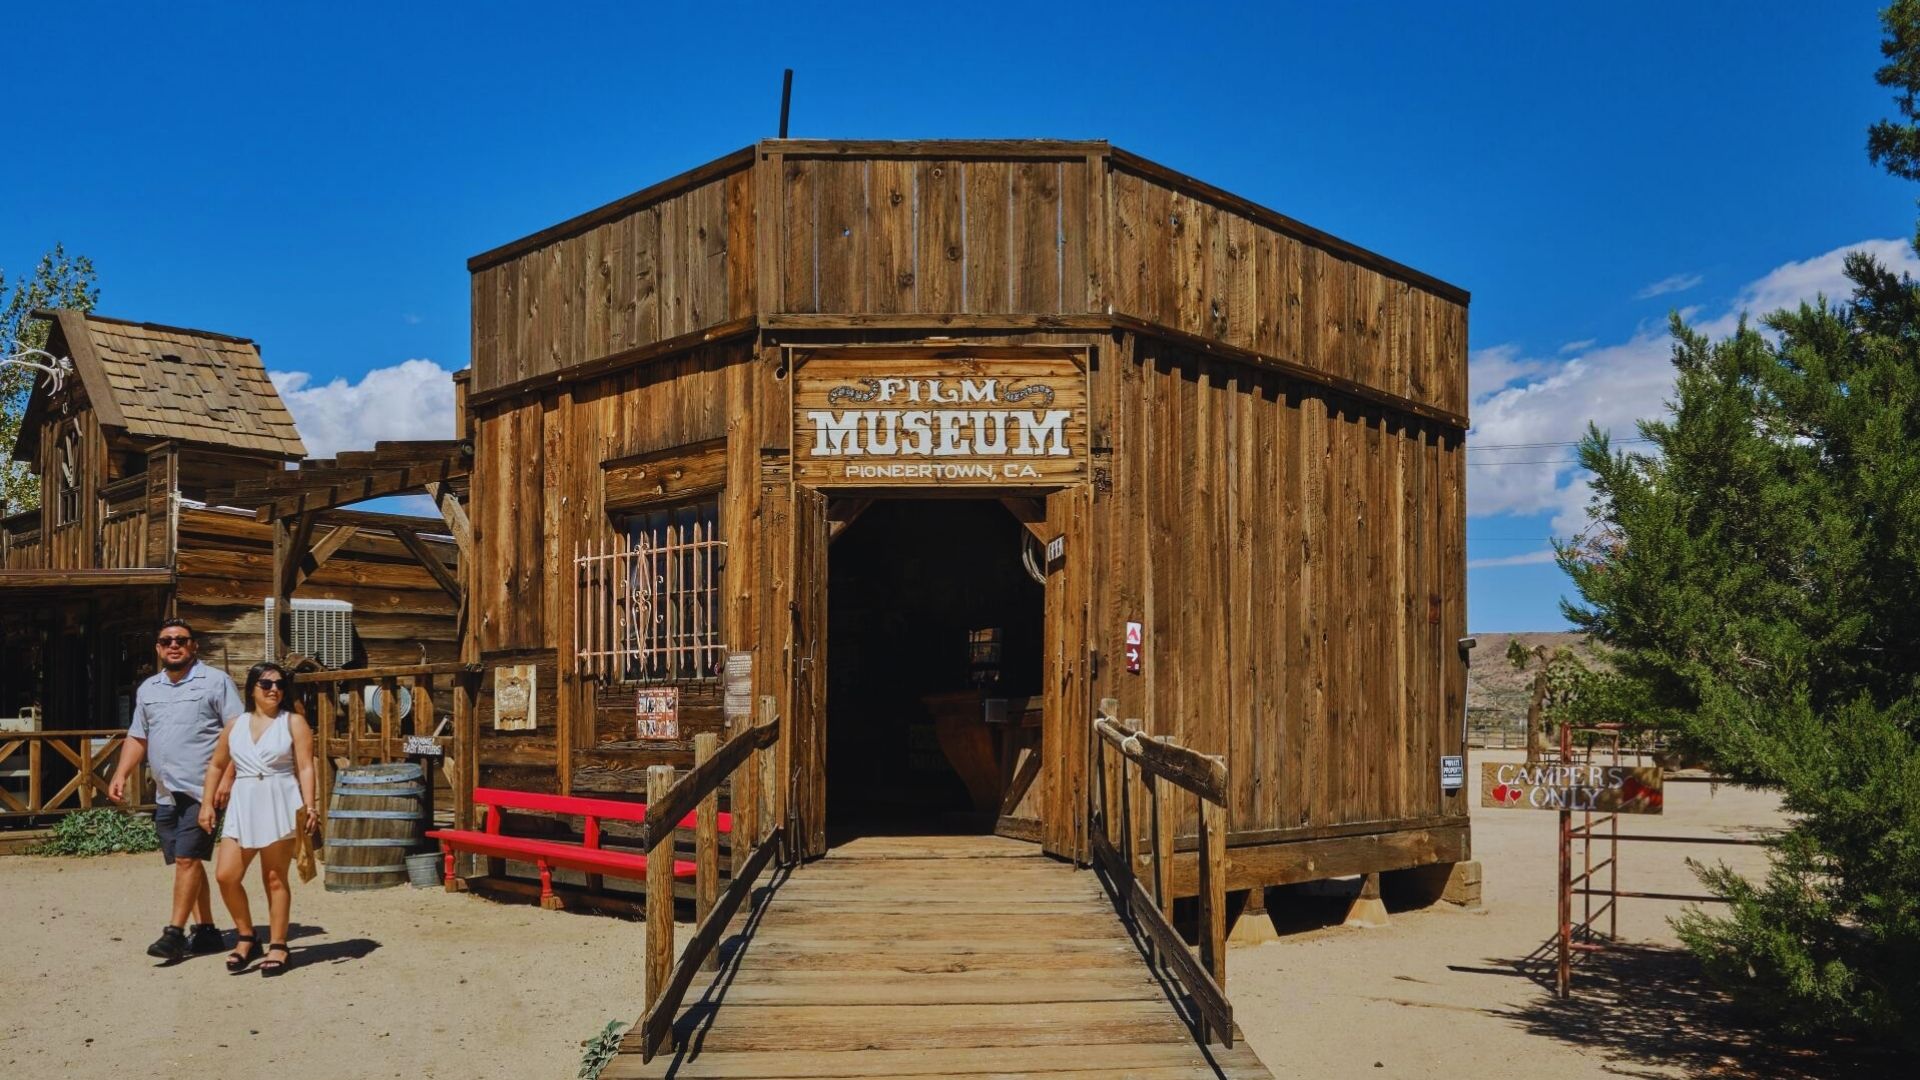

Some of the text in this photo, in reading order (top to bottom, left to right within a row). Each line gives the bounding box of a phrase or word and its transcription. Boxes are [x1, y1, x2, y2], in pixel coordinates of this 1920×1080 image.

[876, 378, 998, 403] FILM
[807, 410, 1072, 456] MUSEUM
[846, 464, 1043, 481] PIONEERTOWN, CA.
[1498, 765, 1624, 788] CAMPERS
[1529, 786, 1604, 809] ONLY
